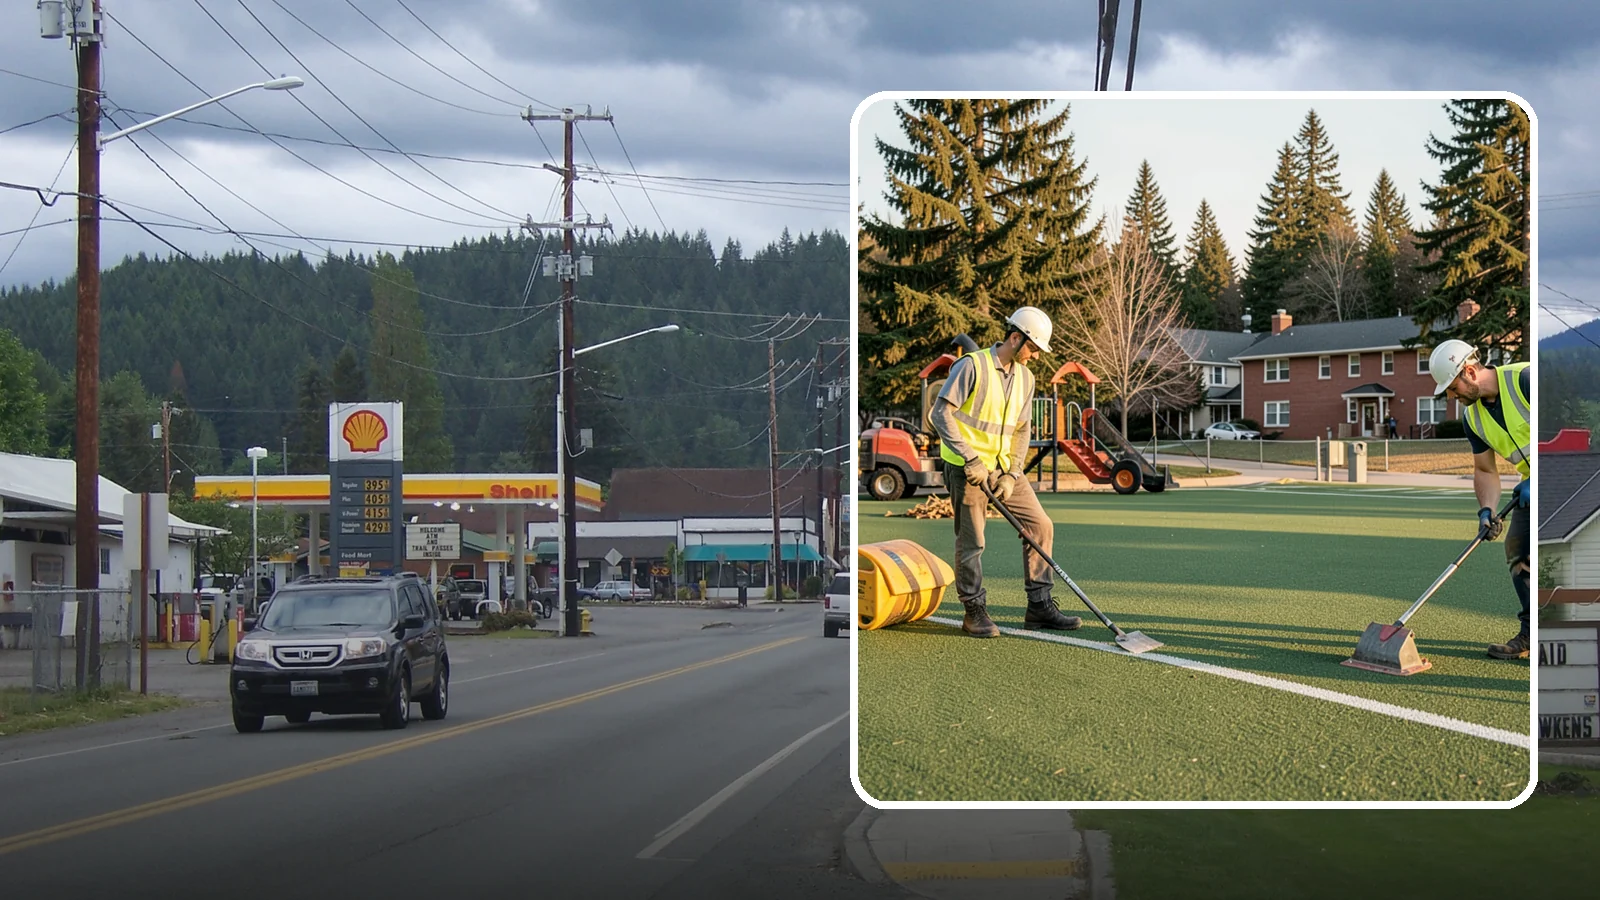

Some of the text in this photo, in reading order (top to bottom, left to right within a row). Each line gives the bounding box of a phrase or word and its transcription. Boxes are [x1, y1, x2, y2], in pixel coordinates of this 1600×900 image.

[366, 480, 383, 490] 395
[490, 484, 547, 499] Shell
[366, 494, 383, 504] 405
[366, 508, 383, 518] 415
[366, 522, 383, 532] 429
[1539, 643, 1567, 666] AID
